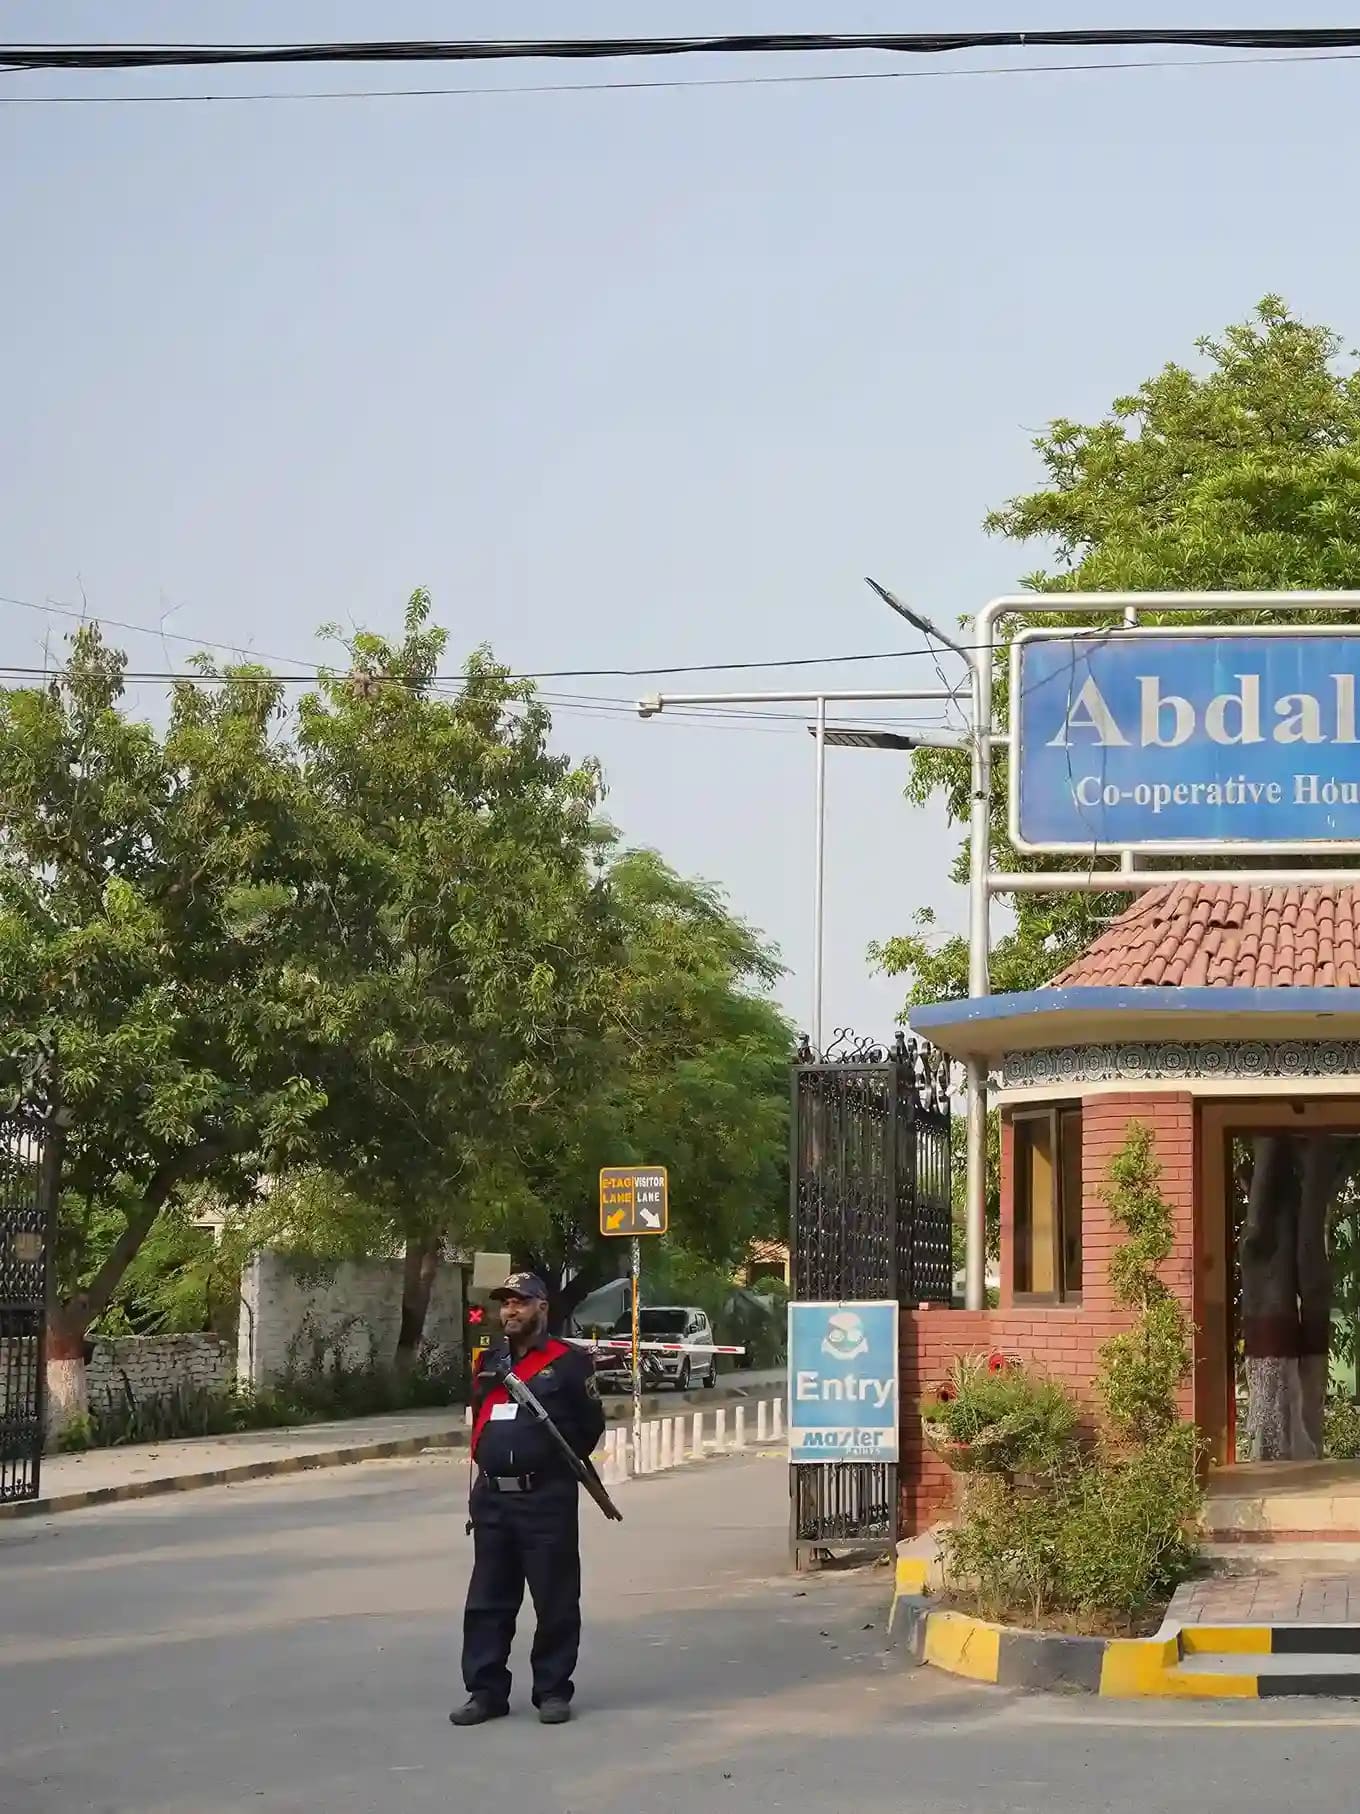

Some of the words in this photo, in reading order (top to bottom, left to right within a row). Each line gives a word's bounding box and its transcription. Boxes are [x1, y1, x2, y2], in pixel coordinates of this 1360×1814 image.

[1076, 774, 1282, 814] Co-operative
[602, 1178, 631, 1188] E-TAG
[635, 1176, 664, 1187] VISITOR
[603, 1192, 631, 1203] LANE
[637, 1192, 660, 1202] LANE
[797, 1371, 896, 1408] Entry
